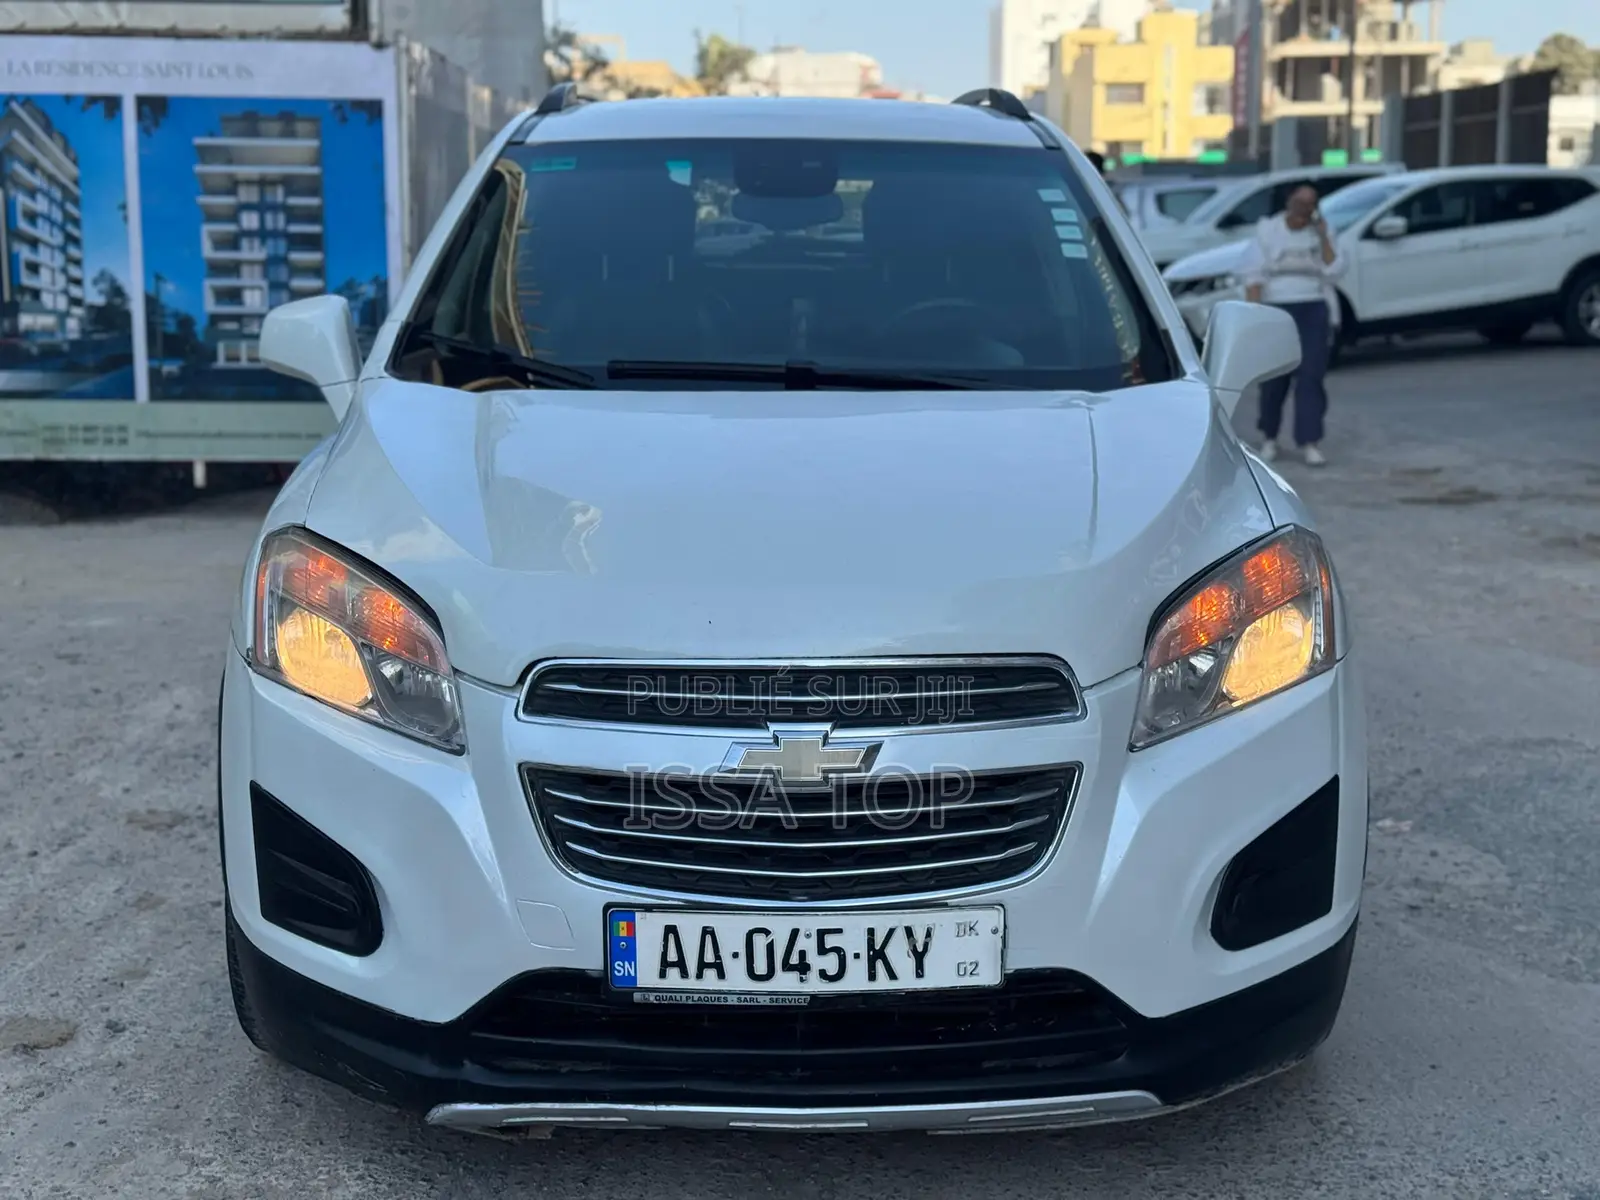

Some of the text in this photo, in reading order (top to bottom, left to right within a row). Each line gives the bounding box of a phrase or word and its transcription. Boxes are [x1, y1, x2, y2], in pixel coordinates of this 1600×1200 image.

[955, 920, 979, 938] DK
[614, 961, 635, 977] SN
[654, 995, 682, 1003] QUALI
[685, 996, 729, 1004] PLAQUES
[736, 996, 761, 1004] SARL
